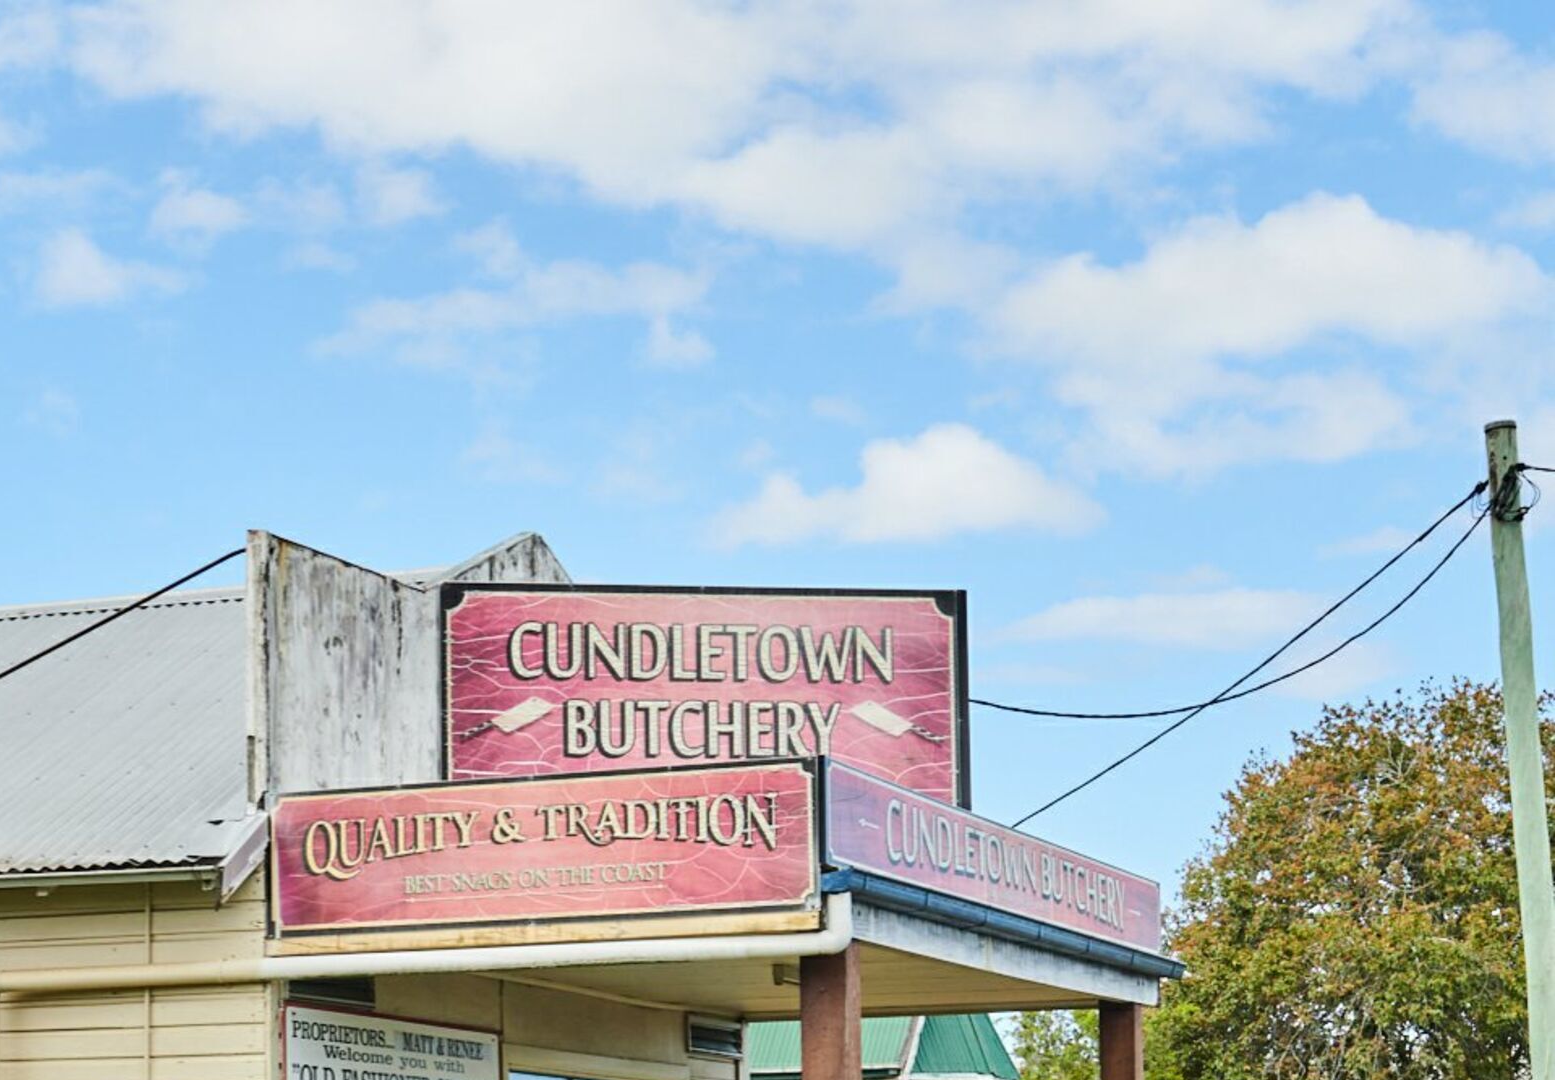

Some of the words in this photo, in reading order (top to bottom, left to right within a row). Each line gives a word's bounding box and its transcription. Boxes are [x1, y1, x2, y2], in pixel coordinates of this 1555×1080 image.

[507, 621, 893, 683] CUNDLETOWN
[565, 699, 841, 758] BUTCHERY
[304, 811, 480, 880] QUALITY
[491, 808, 527, 844] &
[536, 791, 779, 850] TRADITION
[404, 874, 446, 895] BEST
[450, 872, 512, 892] SNAGS
[518, 869, 550, 889] ON
[556, 867, 596, 888] THE
[600, 863, 669, 885] COAST
[885, 799, 1037, 893] CUNDLETOWN
[1041, 853, 1127, 932] BUTCHERY
[323, 1044, 393, 1065] Welcome
[399, 1055, 427, 1070] you
[433, 1058, 465, 1074] with
[402, 1031, 435, 1055] MATT
[436, 1041, 446, 1056] &
[447, 1041, 484, 1061] RENEE
